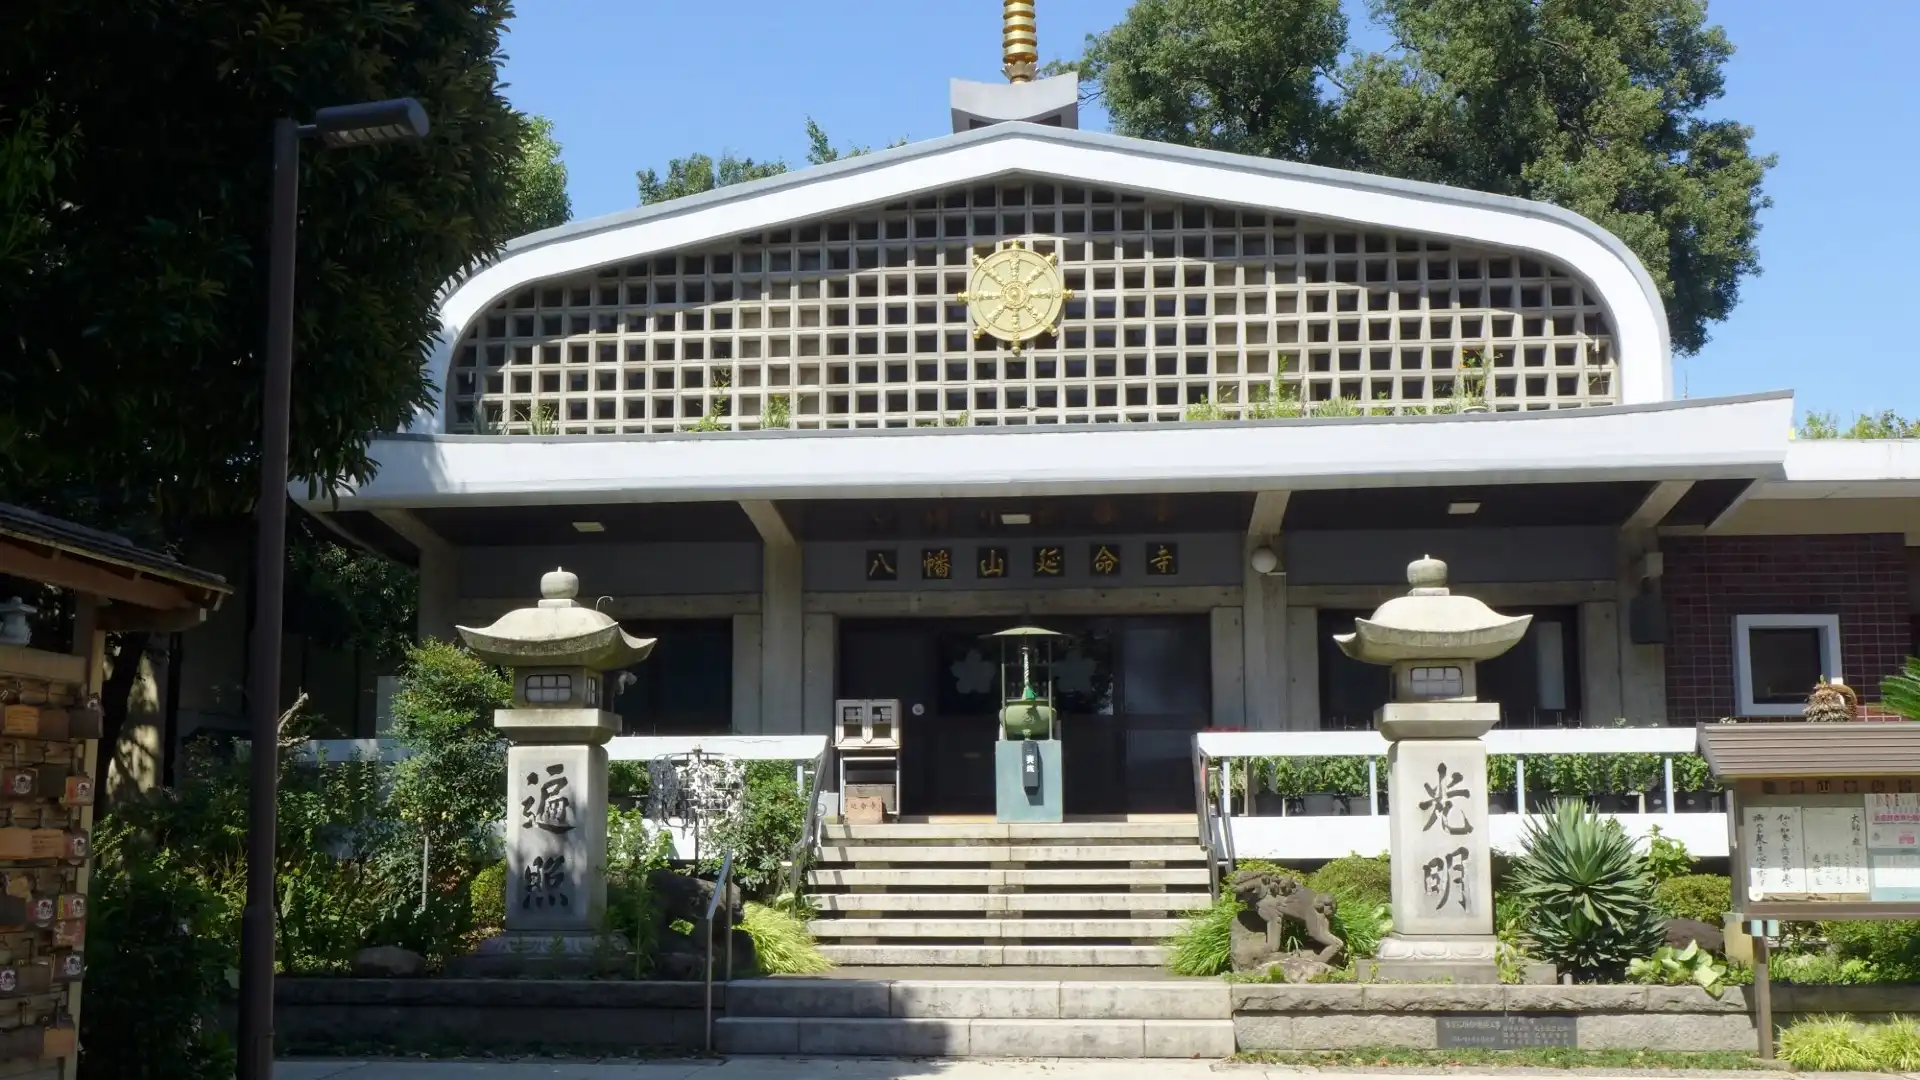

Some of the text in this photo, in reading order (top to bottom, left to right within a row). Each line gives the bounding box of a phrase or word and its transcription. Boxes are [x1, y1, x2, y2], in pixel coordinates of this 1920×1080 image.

[868, 544, 1175, 578] 八幡山延命寺
[1418, 762, 1473, 911] 光明
